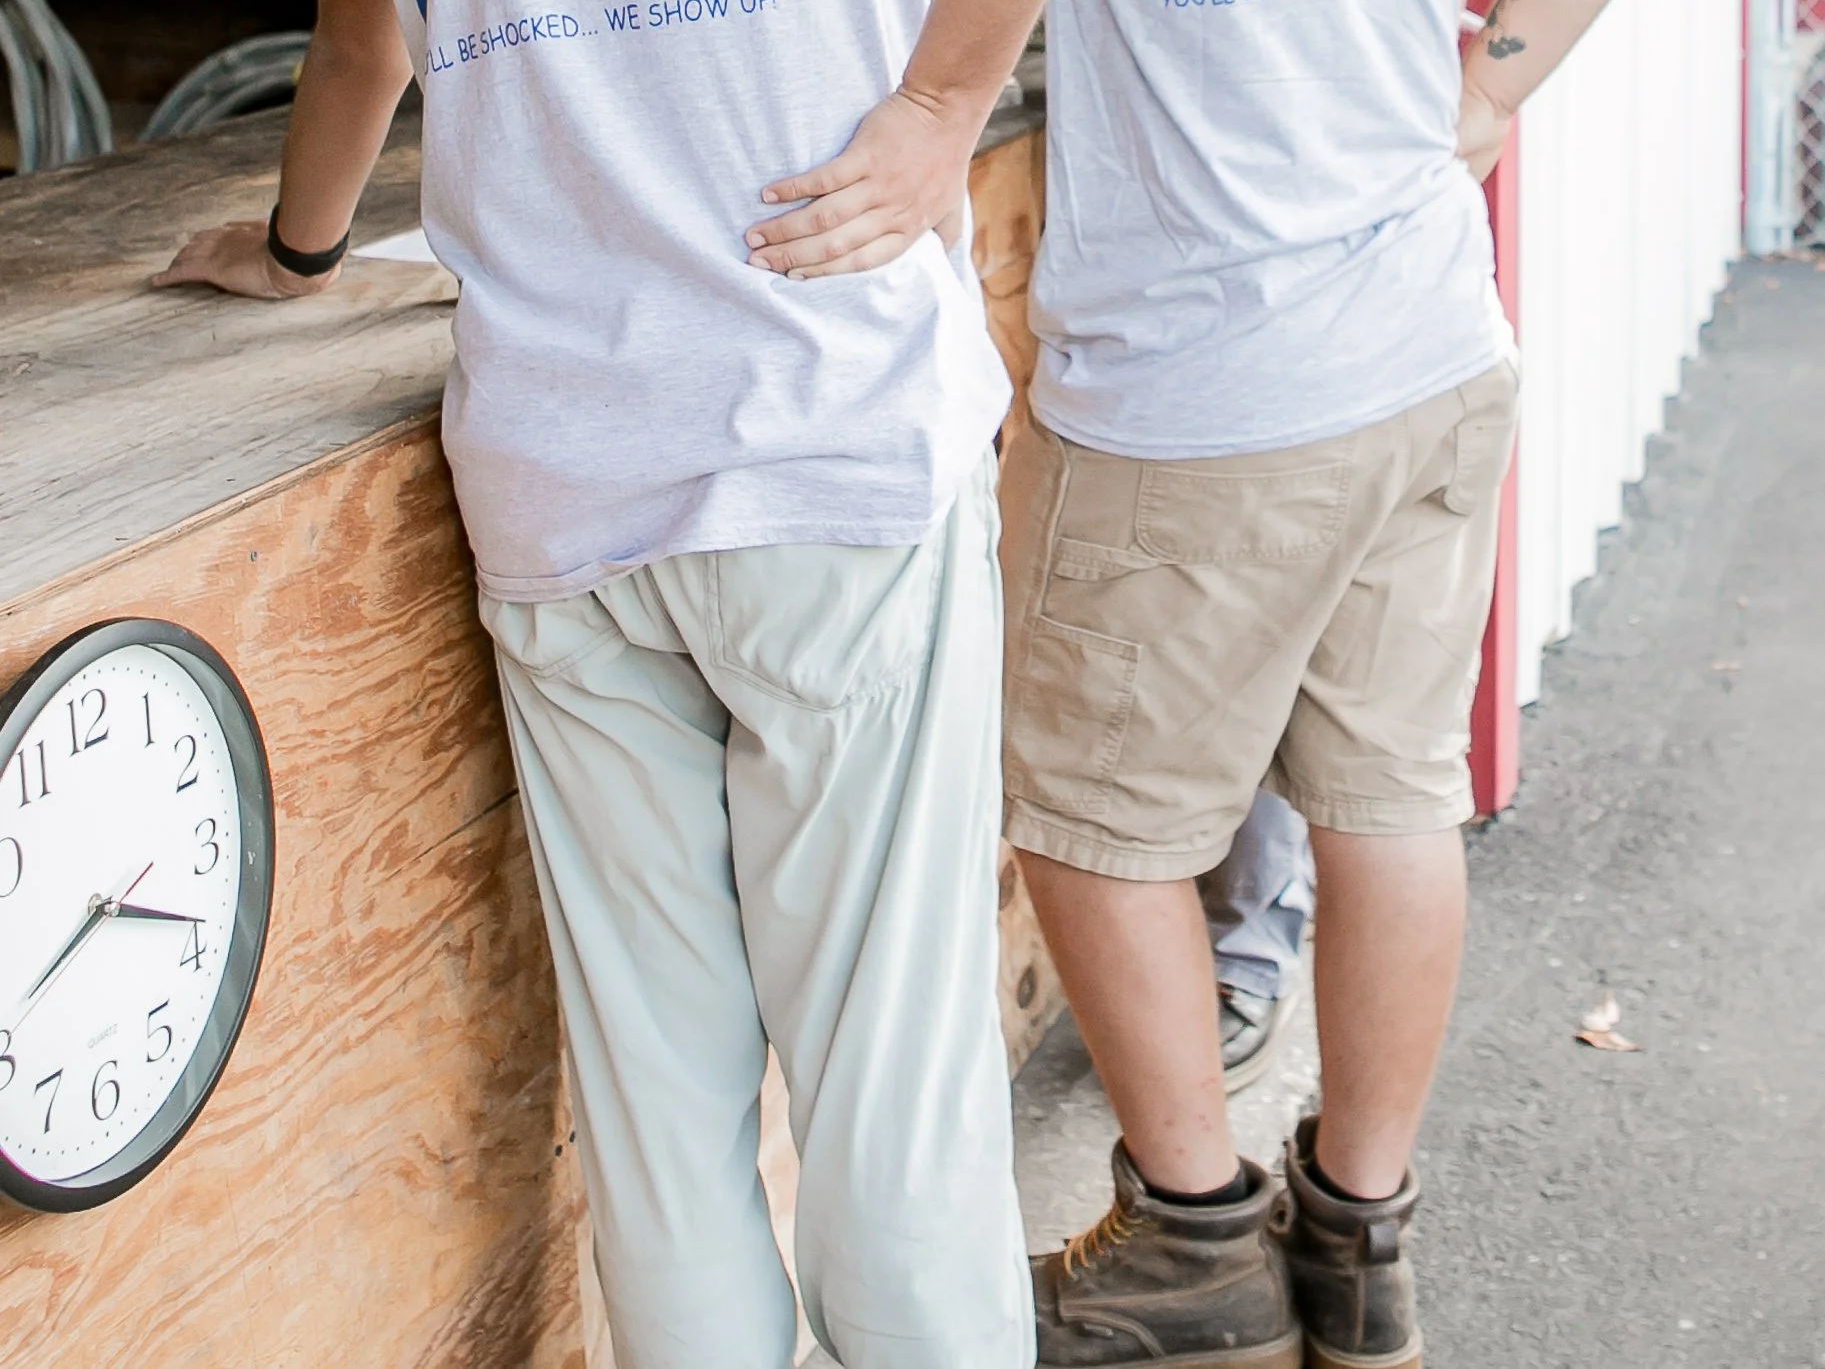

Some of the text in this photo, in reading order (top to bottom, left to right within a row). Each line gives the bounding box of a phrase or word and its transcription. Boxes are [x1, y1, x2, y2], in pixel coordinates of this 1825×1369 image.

[457, 34, 479, 63] BE
[480, 13, 599, 55] SHOCKED...
[604, 4, 641, 32] WE
[67, 688, 109, 758] 12
[142, 692, 155, 748] 1
[16, 739, 52, 809] 11
[174, 734, 200, 794] 2
[194, 818, 219, 875] 3
[179, 920, 208, 972] 4
[146, 998, 172, 1063] 5
[34, 1068, 64, 1134] 7
[91, 1060, 120, 1121] 6
